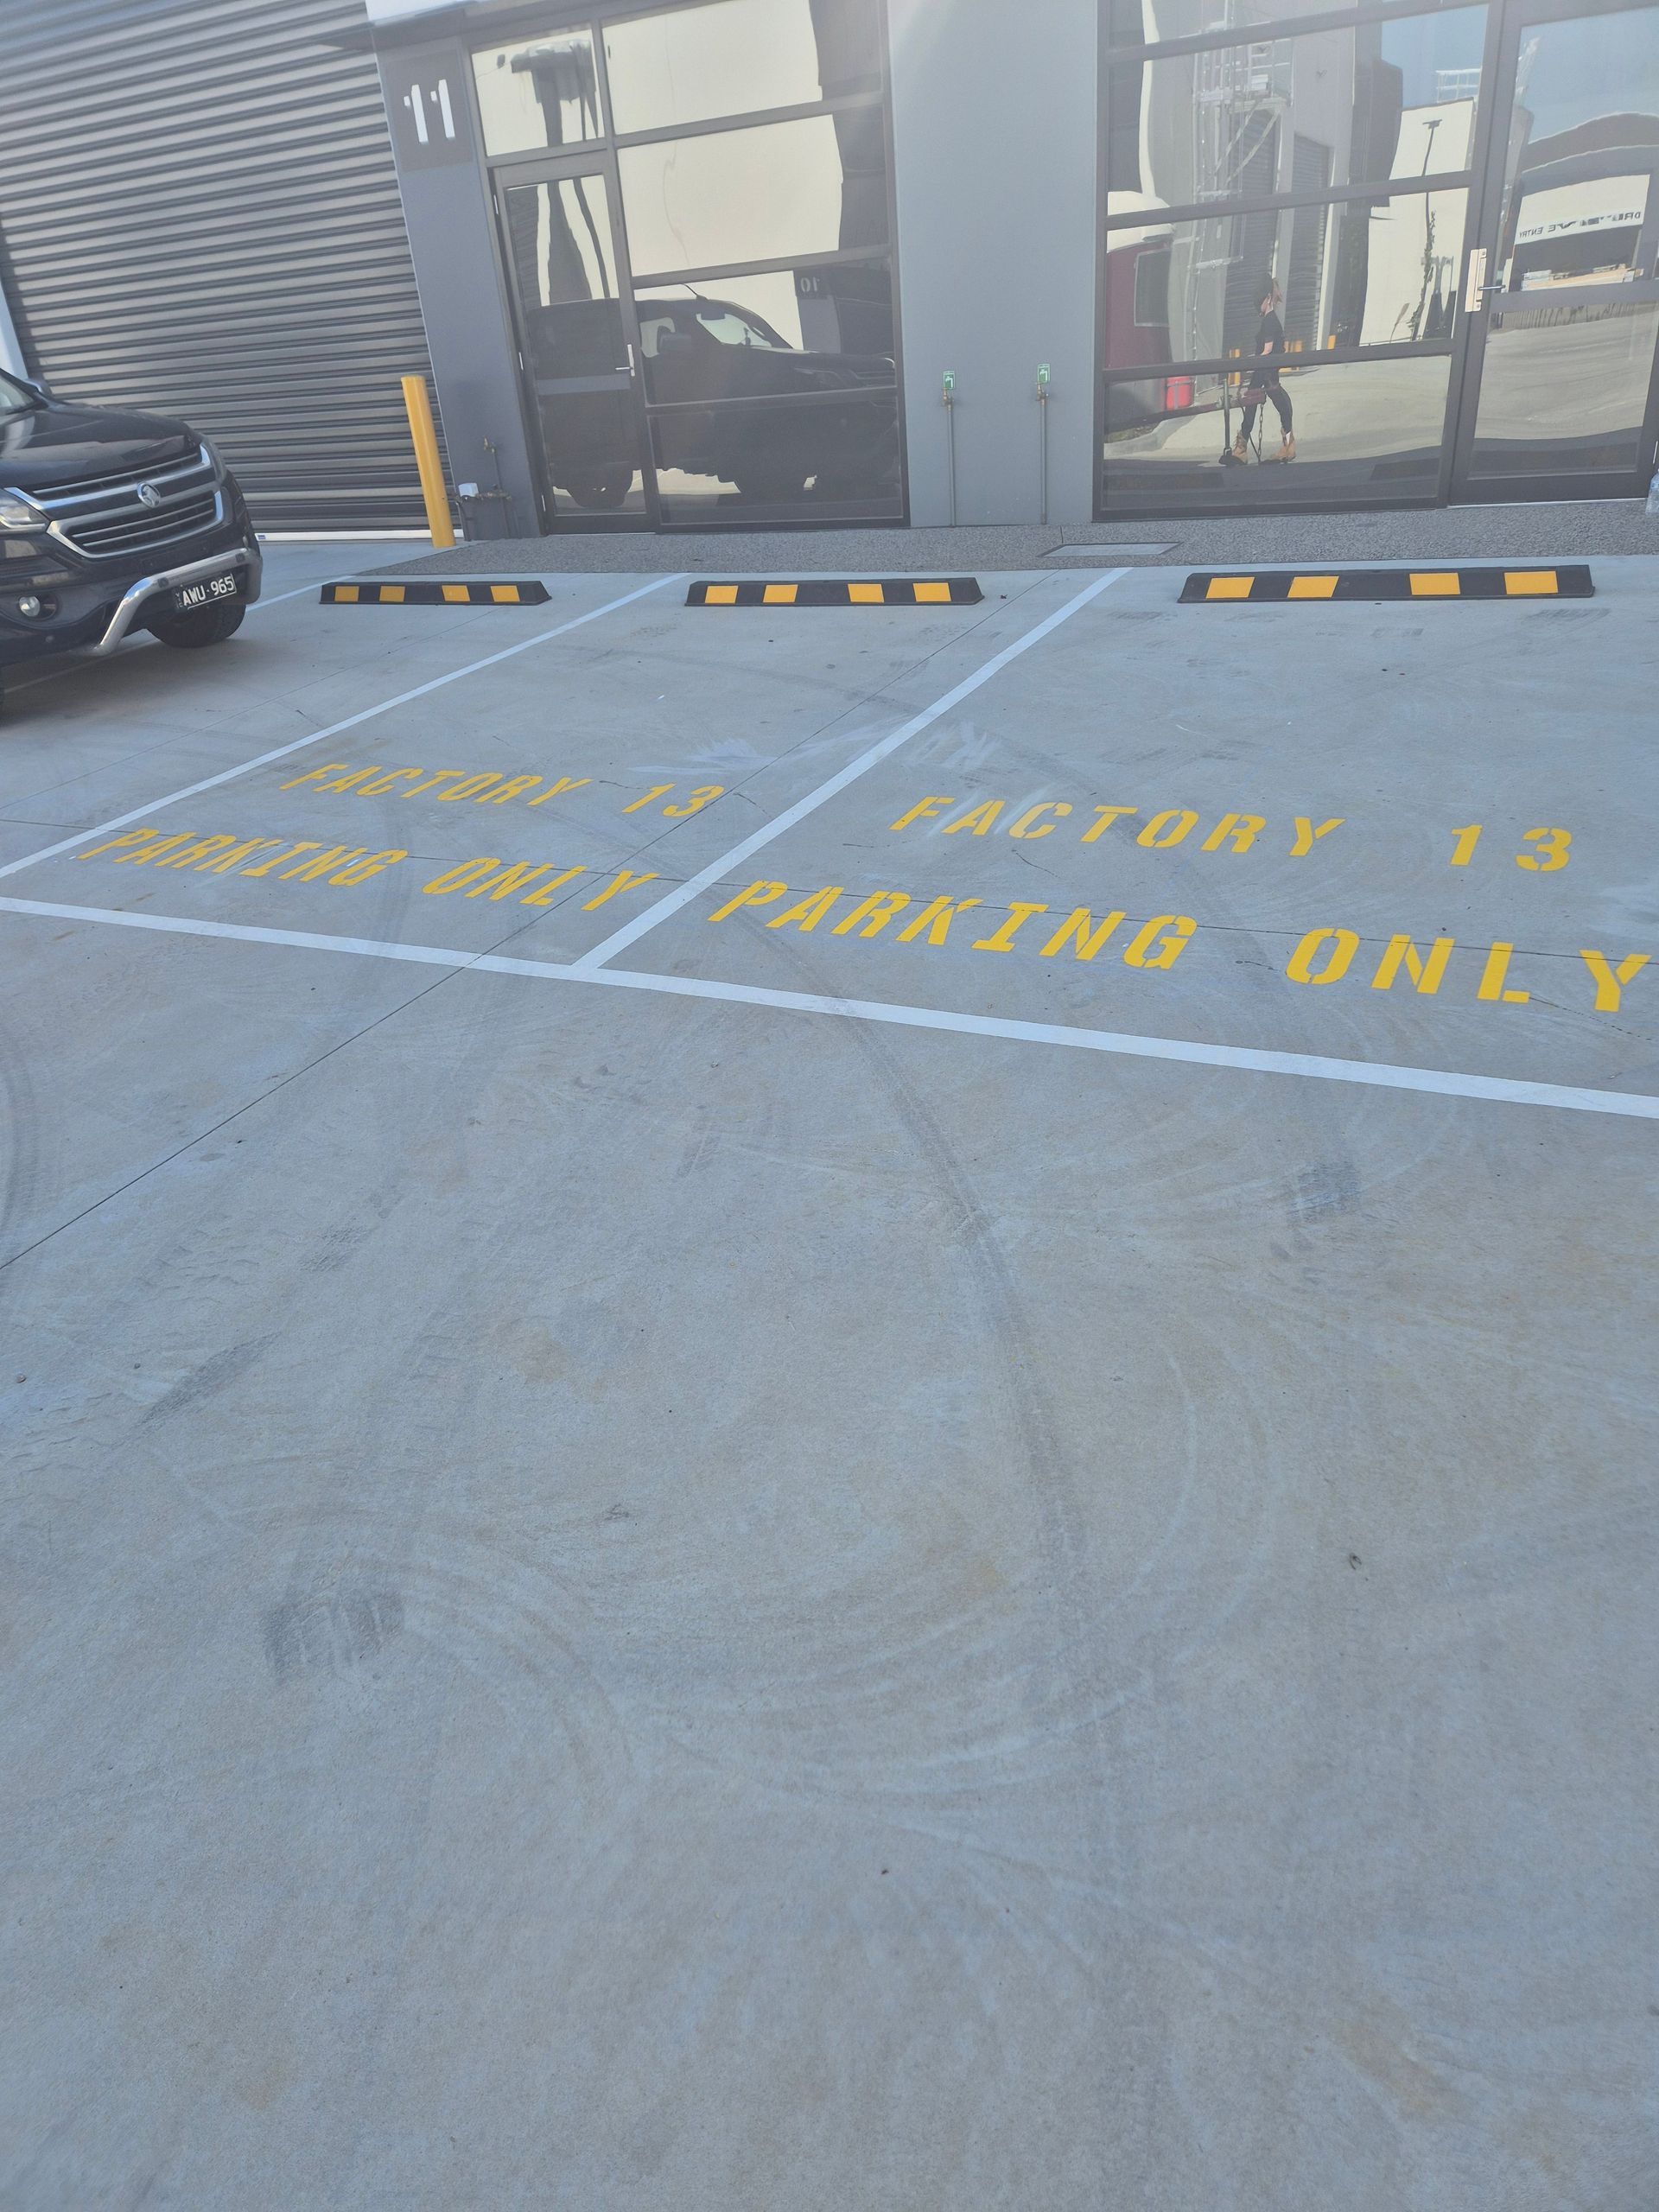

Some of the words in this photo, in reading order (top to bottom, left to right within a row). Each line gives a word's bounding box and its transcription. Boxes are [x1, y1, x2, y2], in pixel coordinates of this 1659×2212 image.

[404, 79, 455, 143] 11
[279, 764, 592, 806] FACTORY
[621, 783, 726, 817] 13
[78, 828, 409, 887] PARKING
[422, 857, 659, 912] ONLY
[890, 797, 1344, 858] FACTORY
[1449, 823, 1573, 872] 13
[708, 880, 1198, 969] PARKING
[1285, 927, 1651, 1013] ONLY
